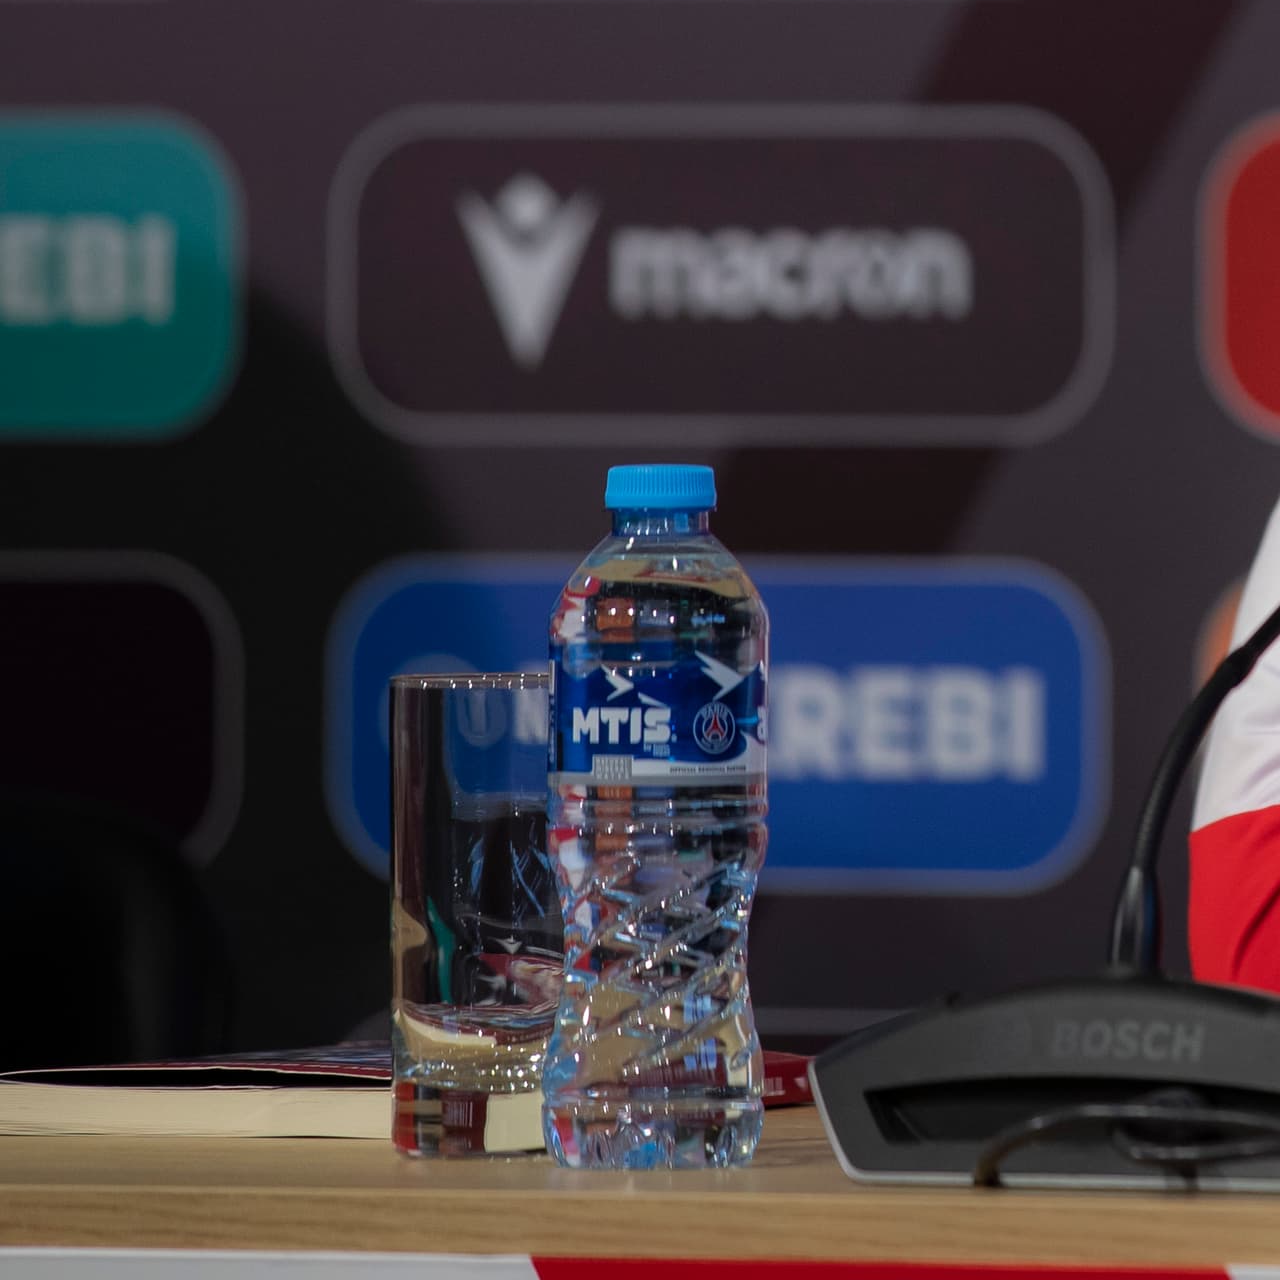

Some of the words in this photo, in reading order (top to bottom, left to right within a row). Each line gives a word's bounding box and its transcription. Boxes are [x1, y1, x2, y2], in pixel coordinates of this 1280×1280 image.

[610, 225, 973, 322] macron
[573, 707, 671, 744] MTIS
[1052, 1019, 1204, 1063] BOSCH
